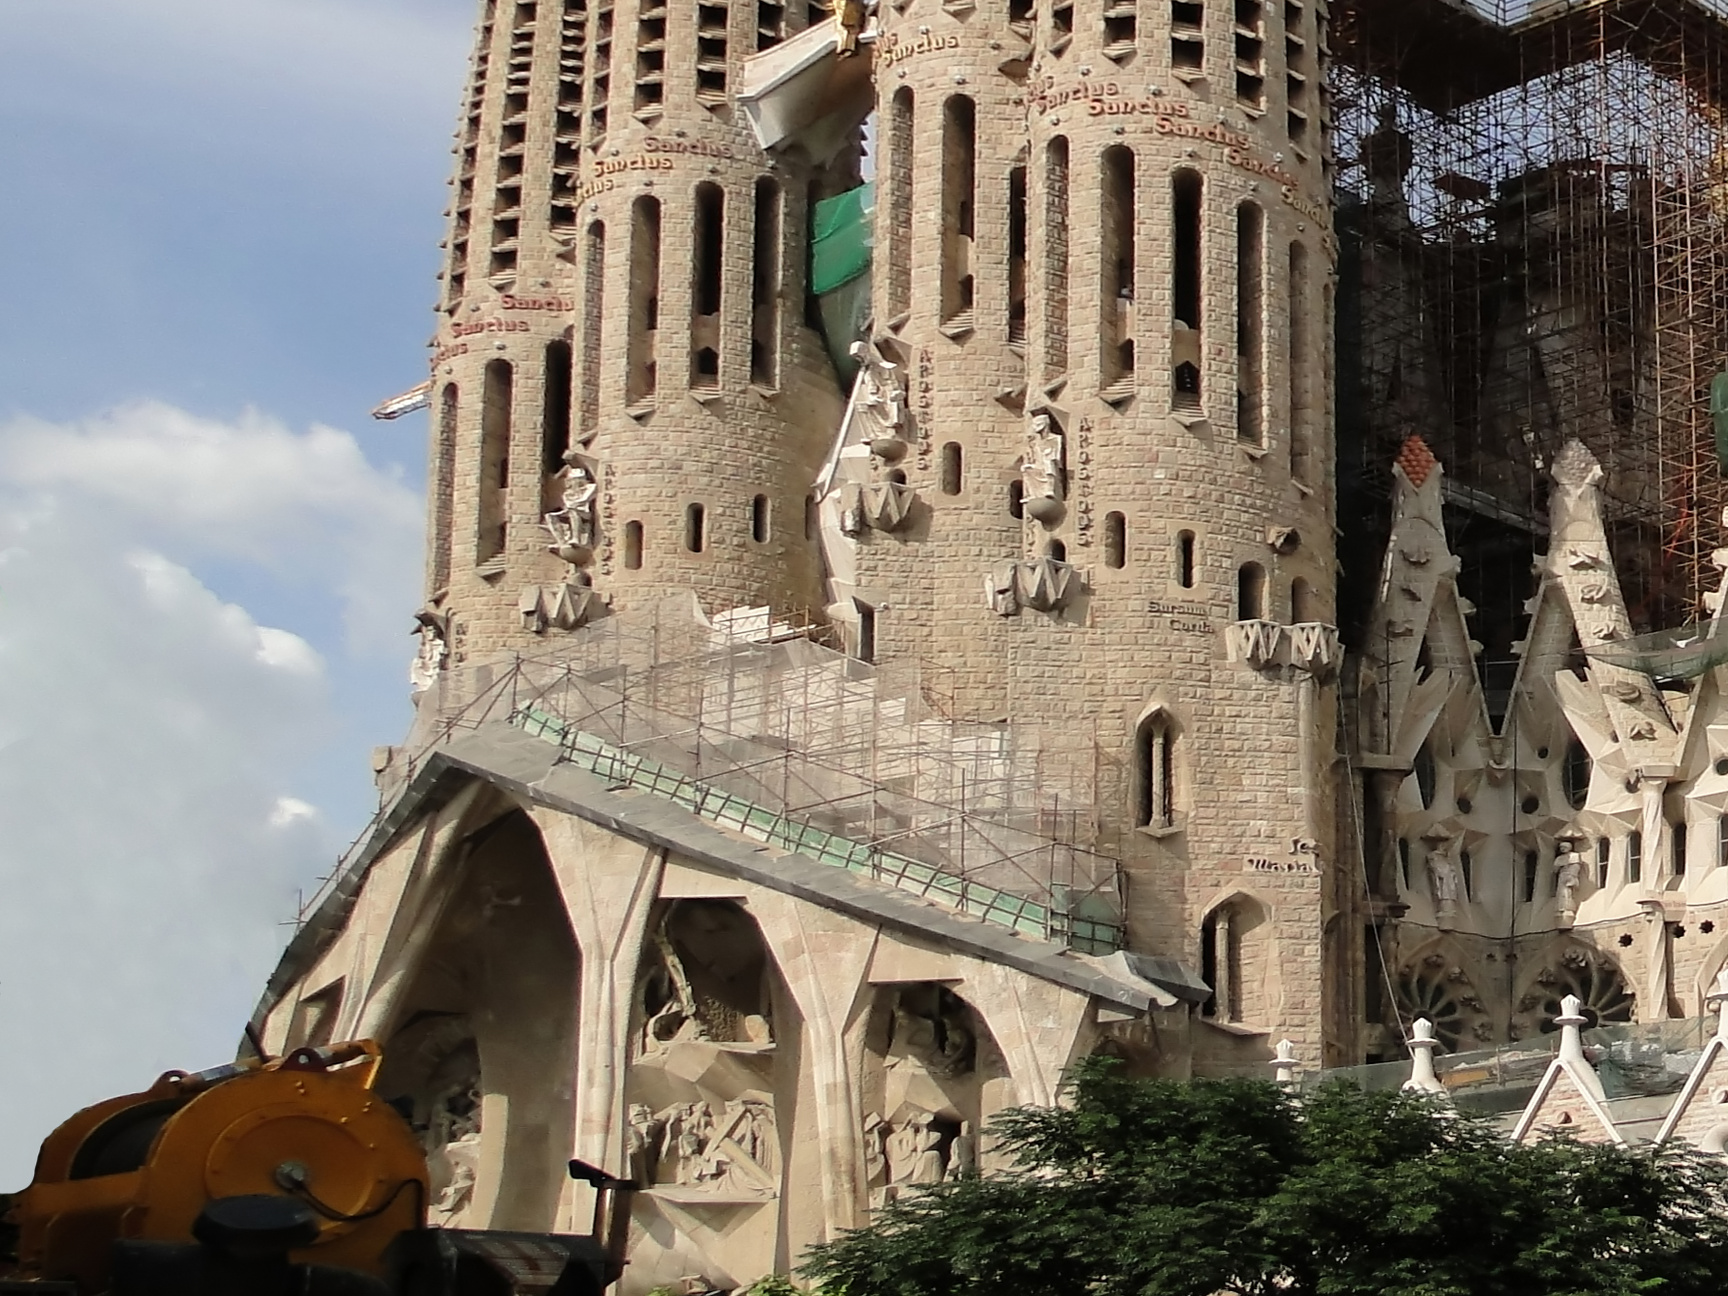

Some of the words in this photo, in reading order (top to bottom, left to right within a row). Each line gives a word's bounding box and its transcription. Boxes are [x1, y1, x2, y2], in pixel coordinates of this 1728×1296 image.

[1088, 96, 1189, 116] Sanctus
[1155, 115, 1251, 149] Sanctus
[592, 154, 675, 177] Sanctus
[501, 293, 574, 311] Sanctu
